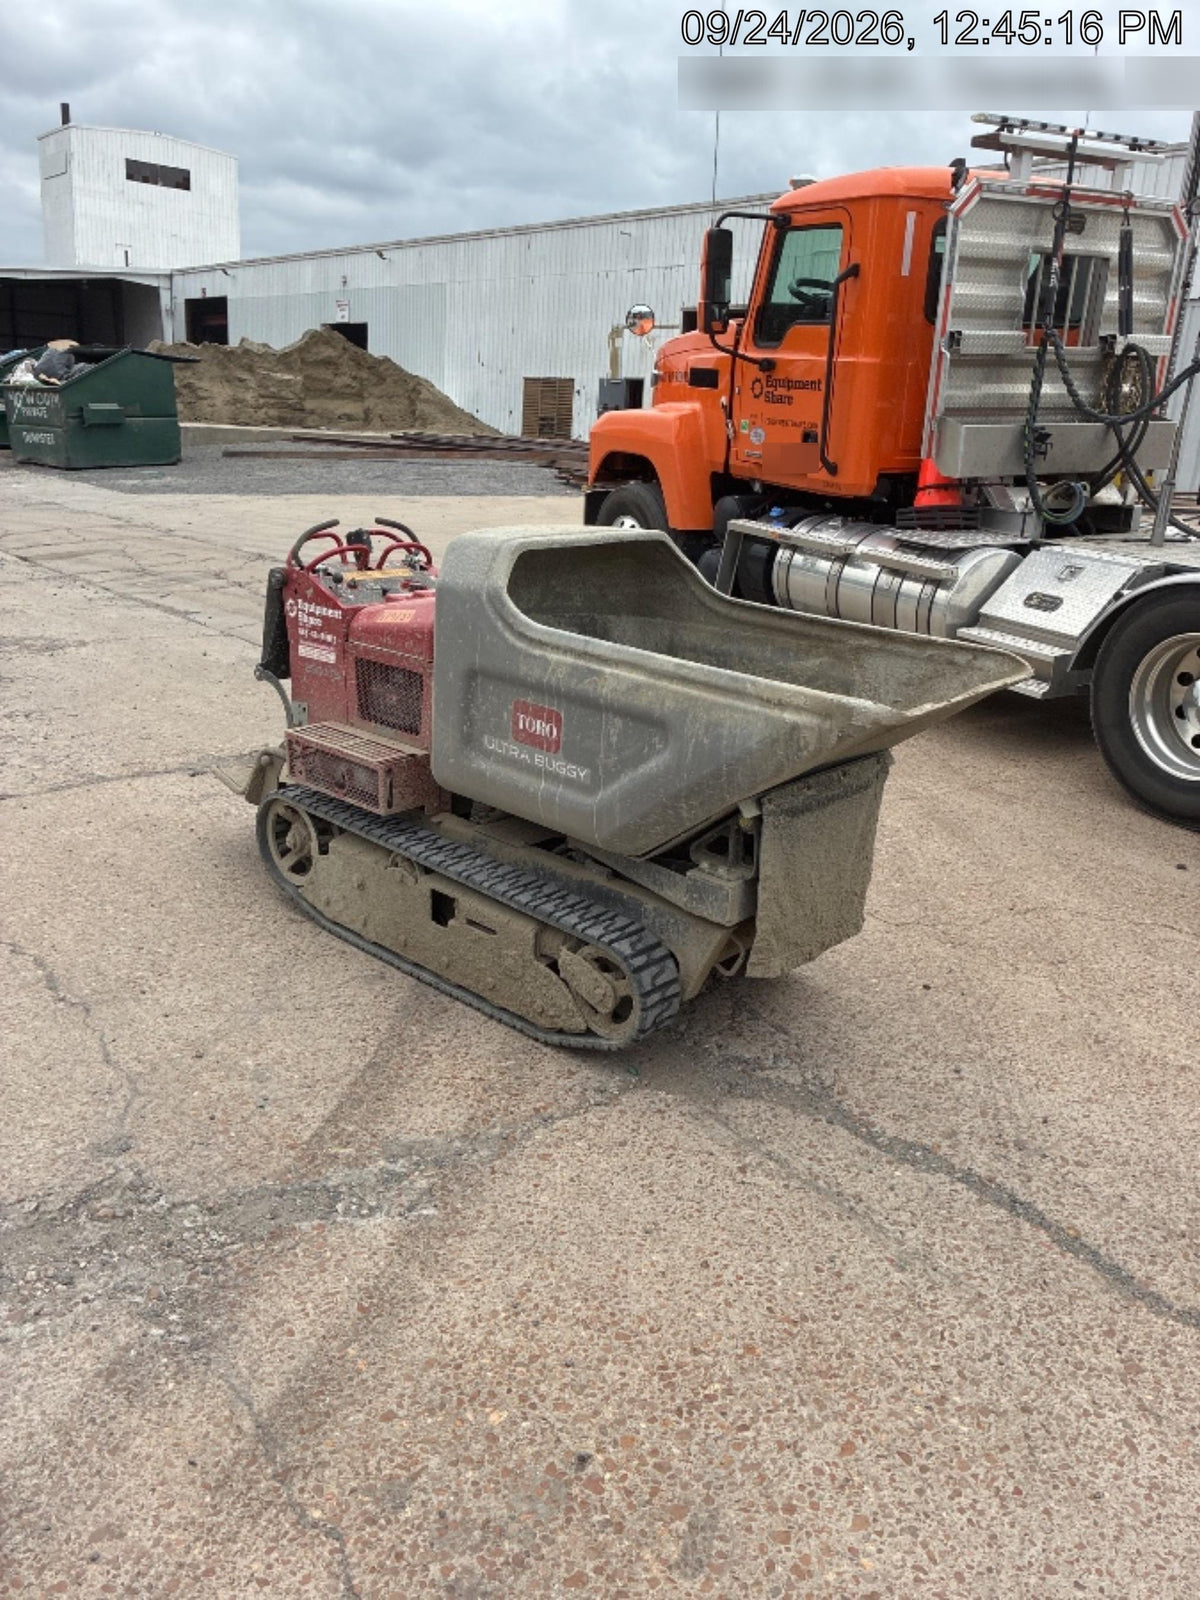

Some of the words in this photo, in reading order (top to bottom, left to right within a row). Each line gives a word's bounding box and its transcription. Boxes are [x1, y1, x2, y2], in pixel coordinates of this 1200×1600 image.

[765, 375, 822, 392] Equipment
[764, 391, 794, 406] Share
[297, 599, 342, 620] Equipment
[516, 712, 558, 740] TORO
[484, 734, 531, 764] ULTRA
[534, 753, 588, 781] BUGGY
